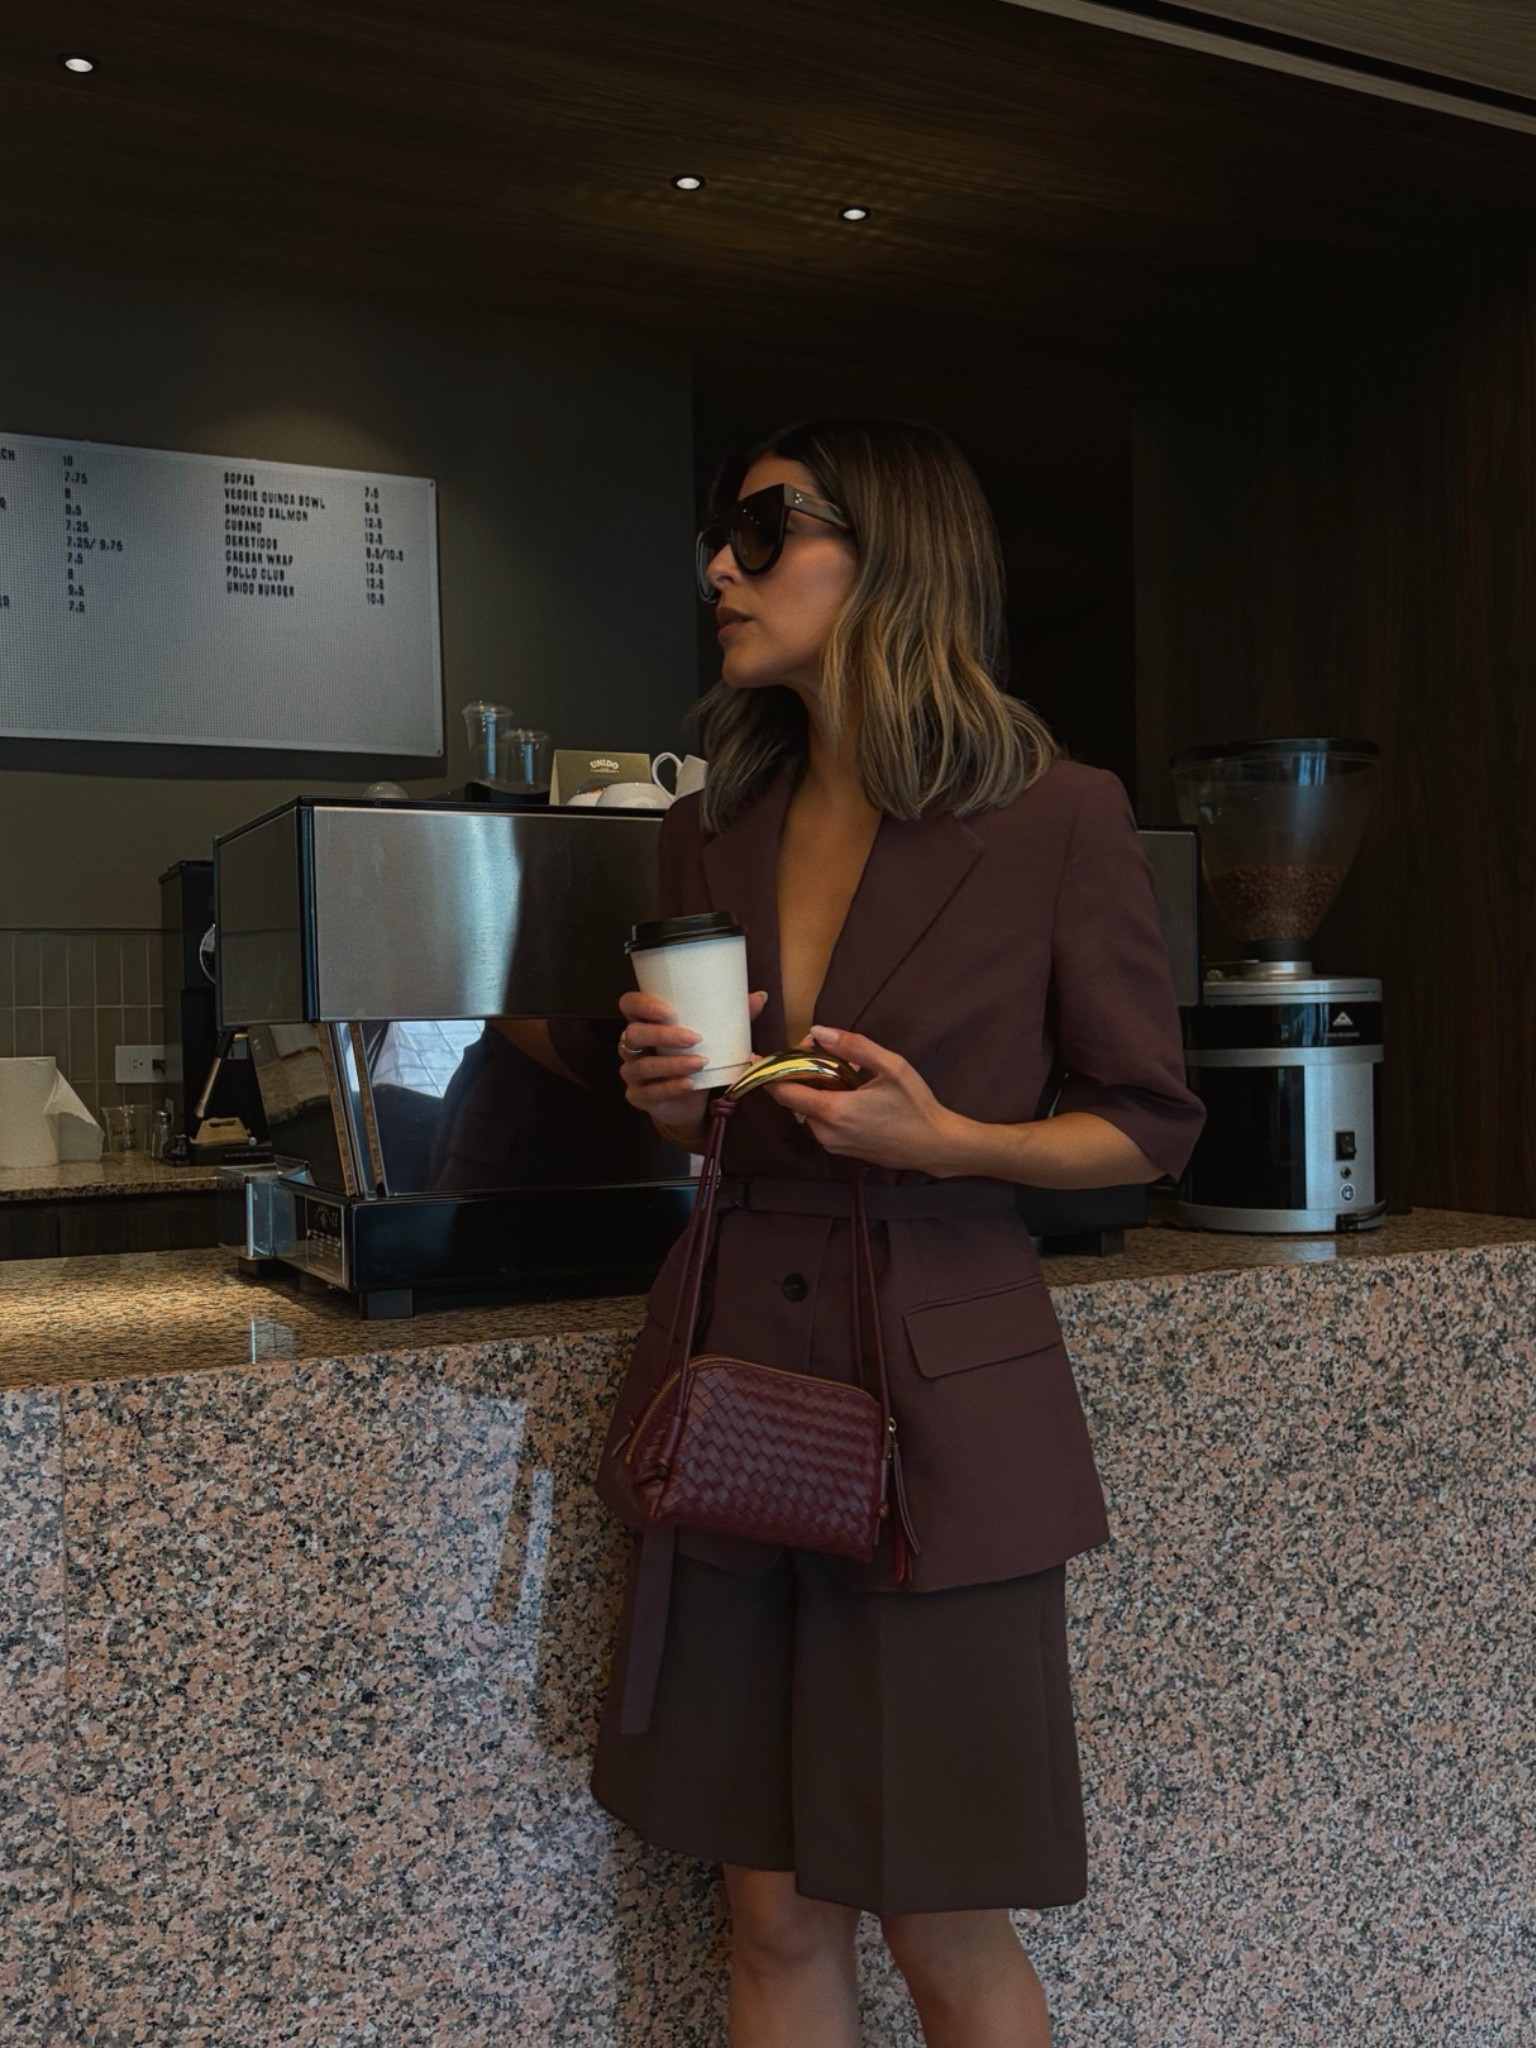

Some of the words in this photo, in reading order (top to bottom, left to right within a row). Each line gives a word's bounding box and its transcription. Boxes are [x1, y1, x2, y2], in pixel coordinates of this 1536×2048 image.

[63, 455, 73, 467] 10
[64, 471, 87, 484] 7.75
[224, 472, 255, 486] SOPAS
[224, 488, 257, 502] VEGGIE
[262, 491, 295, 506] QUINOA
[299, 495, 326, 509] BOWL
[225, 503, 265, 518] SMOKED
[269, 507, 309, 522] SALMON
[66, 519, 89, 533] 7.25
[225, 518, 262, 534] CUBANO
[67, 551, 83, 565] 7.5
[226, 549, 263, 564] CAESAR
[267, 553, 293, 567] WRAP
[227, 565, 258, 580] POLLO
[261, 568, 284, 582] CLUB
[227, 581, 255, 595] UNIDO
[258, 583, 294, 598] BURGER
[69, 600, 85, 613] 7.5
[589, 759, 620, 770] UNIDO
